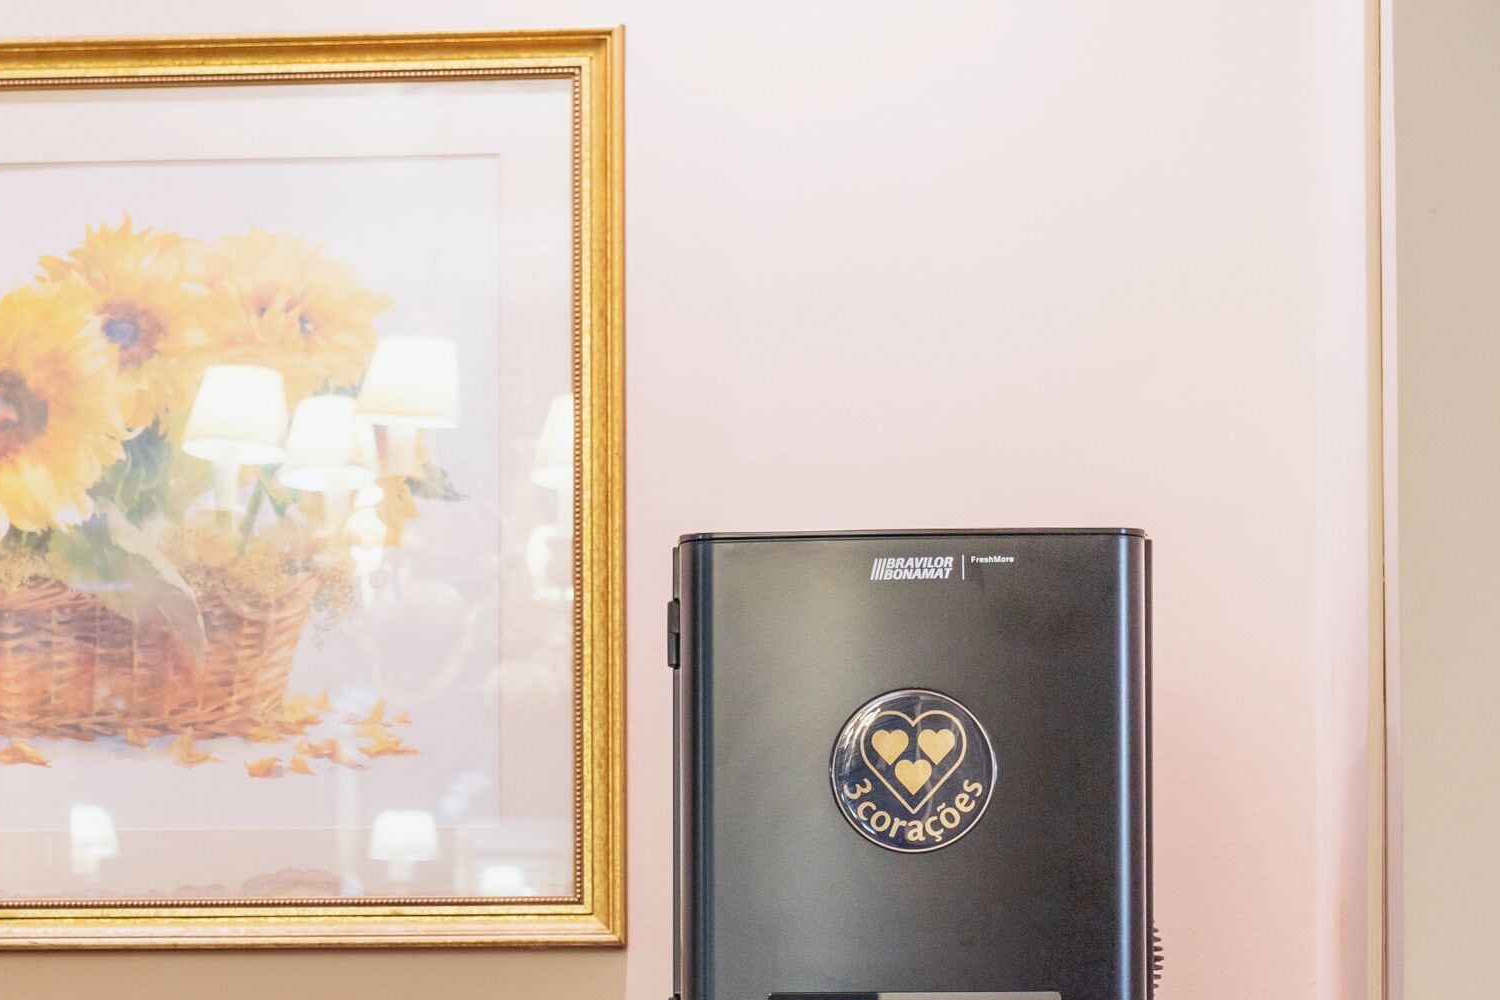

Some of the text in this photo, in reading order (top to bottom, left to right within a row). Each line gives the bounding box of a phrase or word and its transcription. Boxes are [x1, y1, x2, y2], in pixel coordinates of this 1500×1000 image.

[886, 556, 954, 568] BRAVILOR
[971, 555, 1015, 564] FreshMore
[883, 567, 953, 580] BONAMAT
[843, 778, 983, 842] 3 corações
